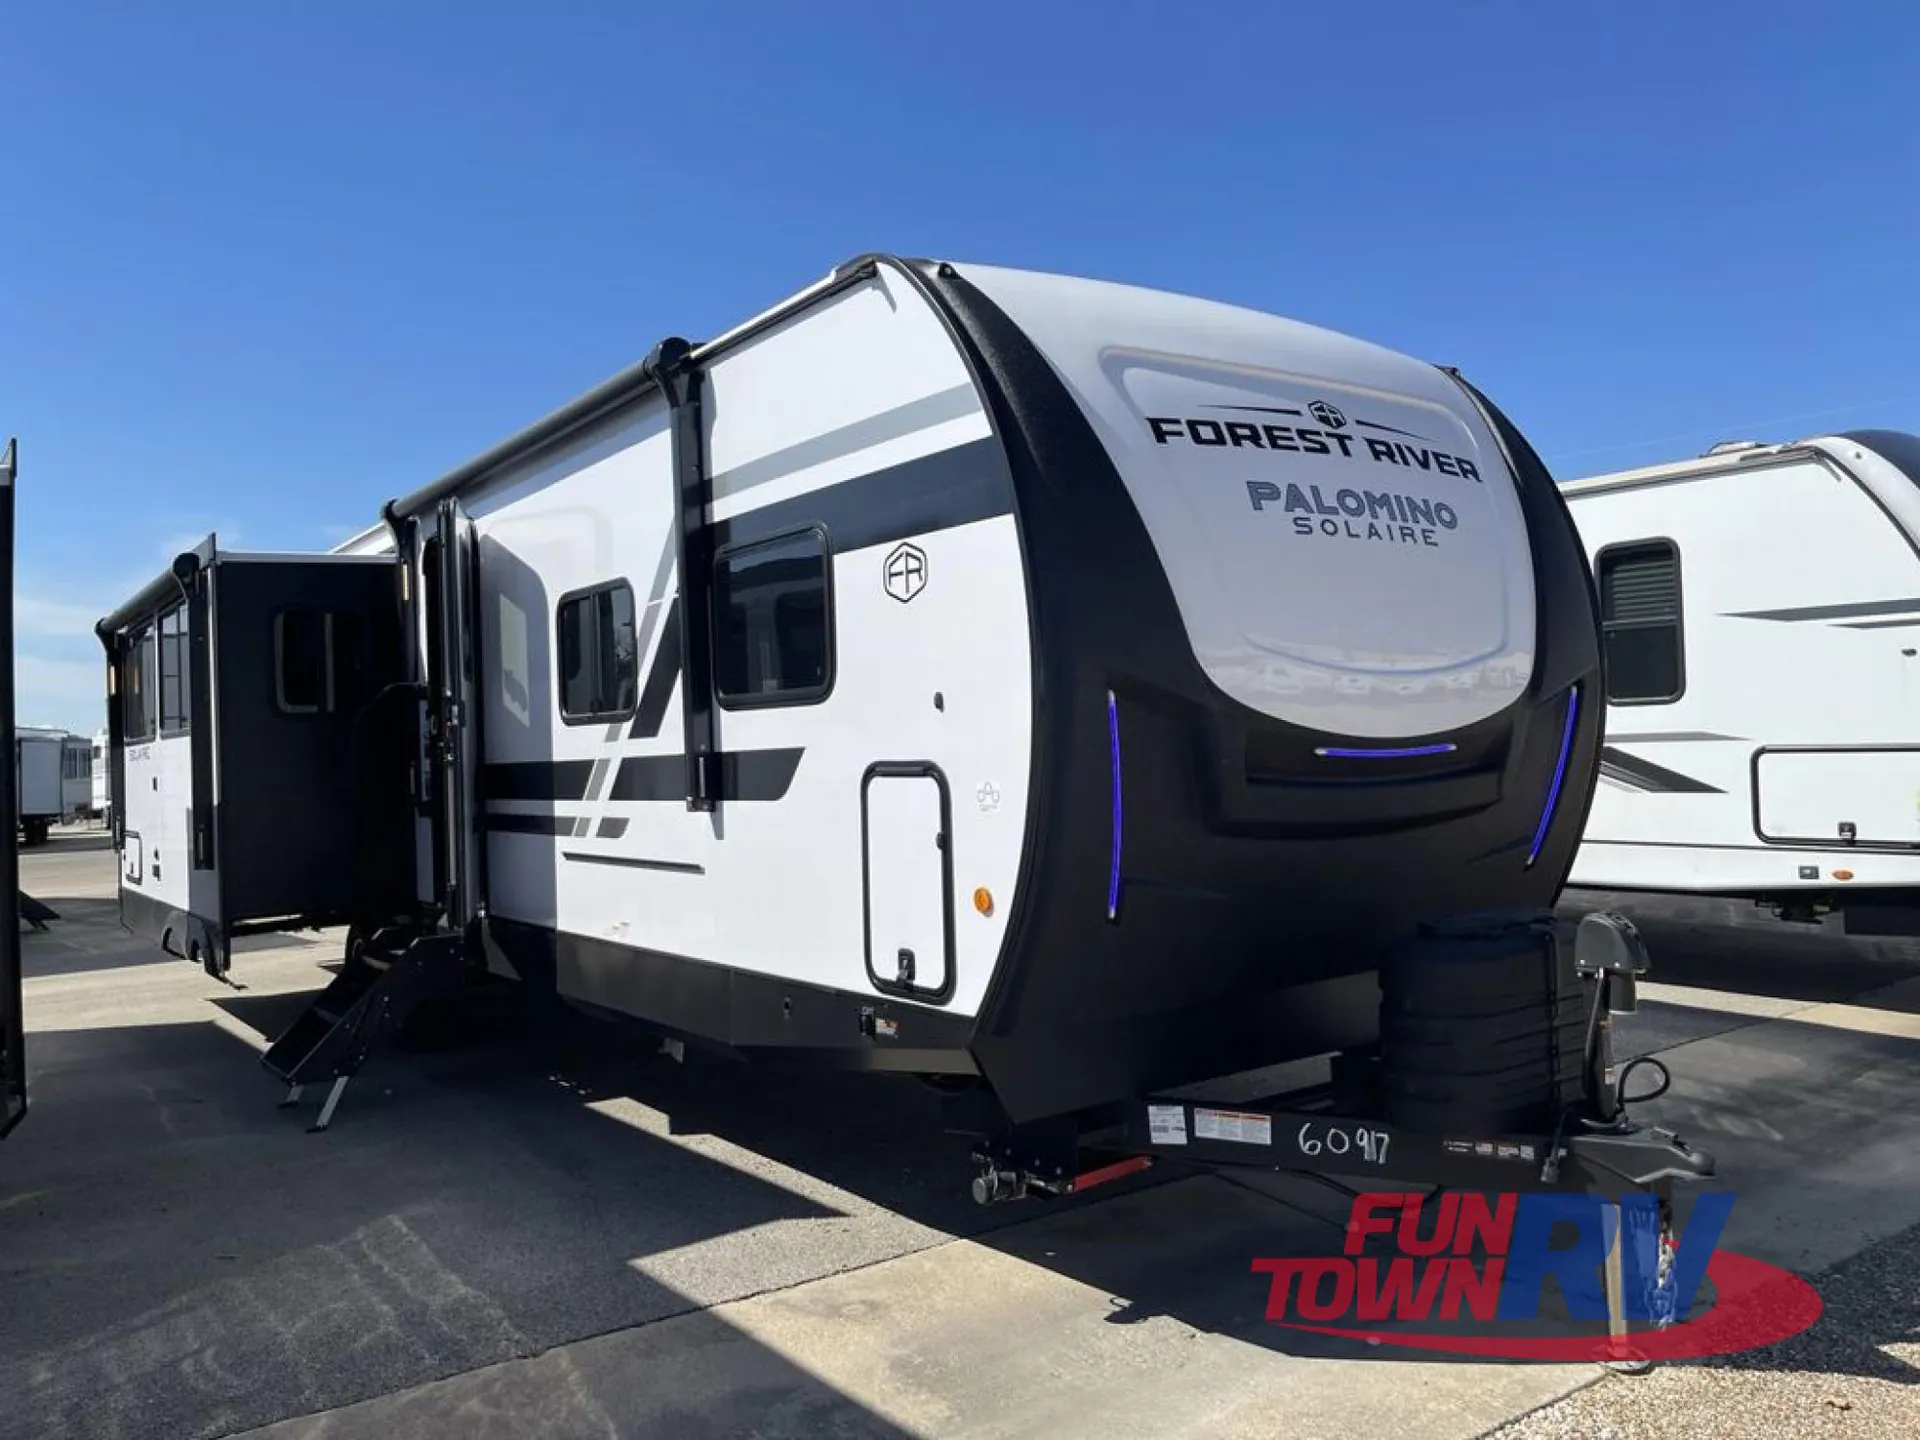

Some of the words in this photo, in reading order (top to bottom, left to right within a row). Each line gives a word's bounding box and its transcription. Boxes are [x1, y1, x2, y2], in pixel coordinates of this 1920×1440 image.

[1145, 417, 1353, 458] FOREST
[1362, 436, 1483, 483] RIVER
[1246, 480, 1458, 530] PALOMINO
[1293, 516, 1439, 547] SOLAIRE
